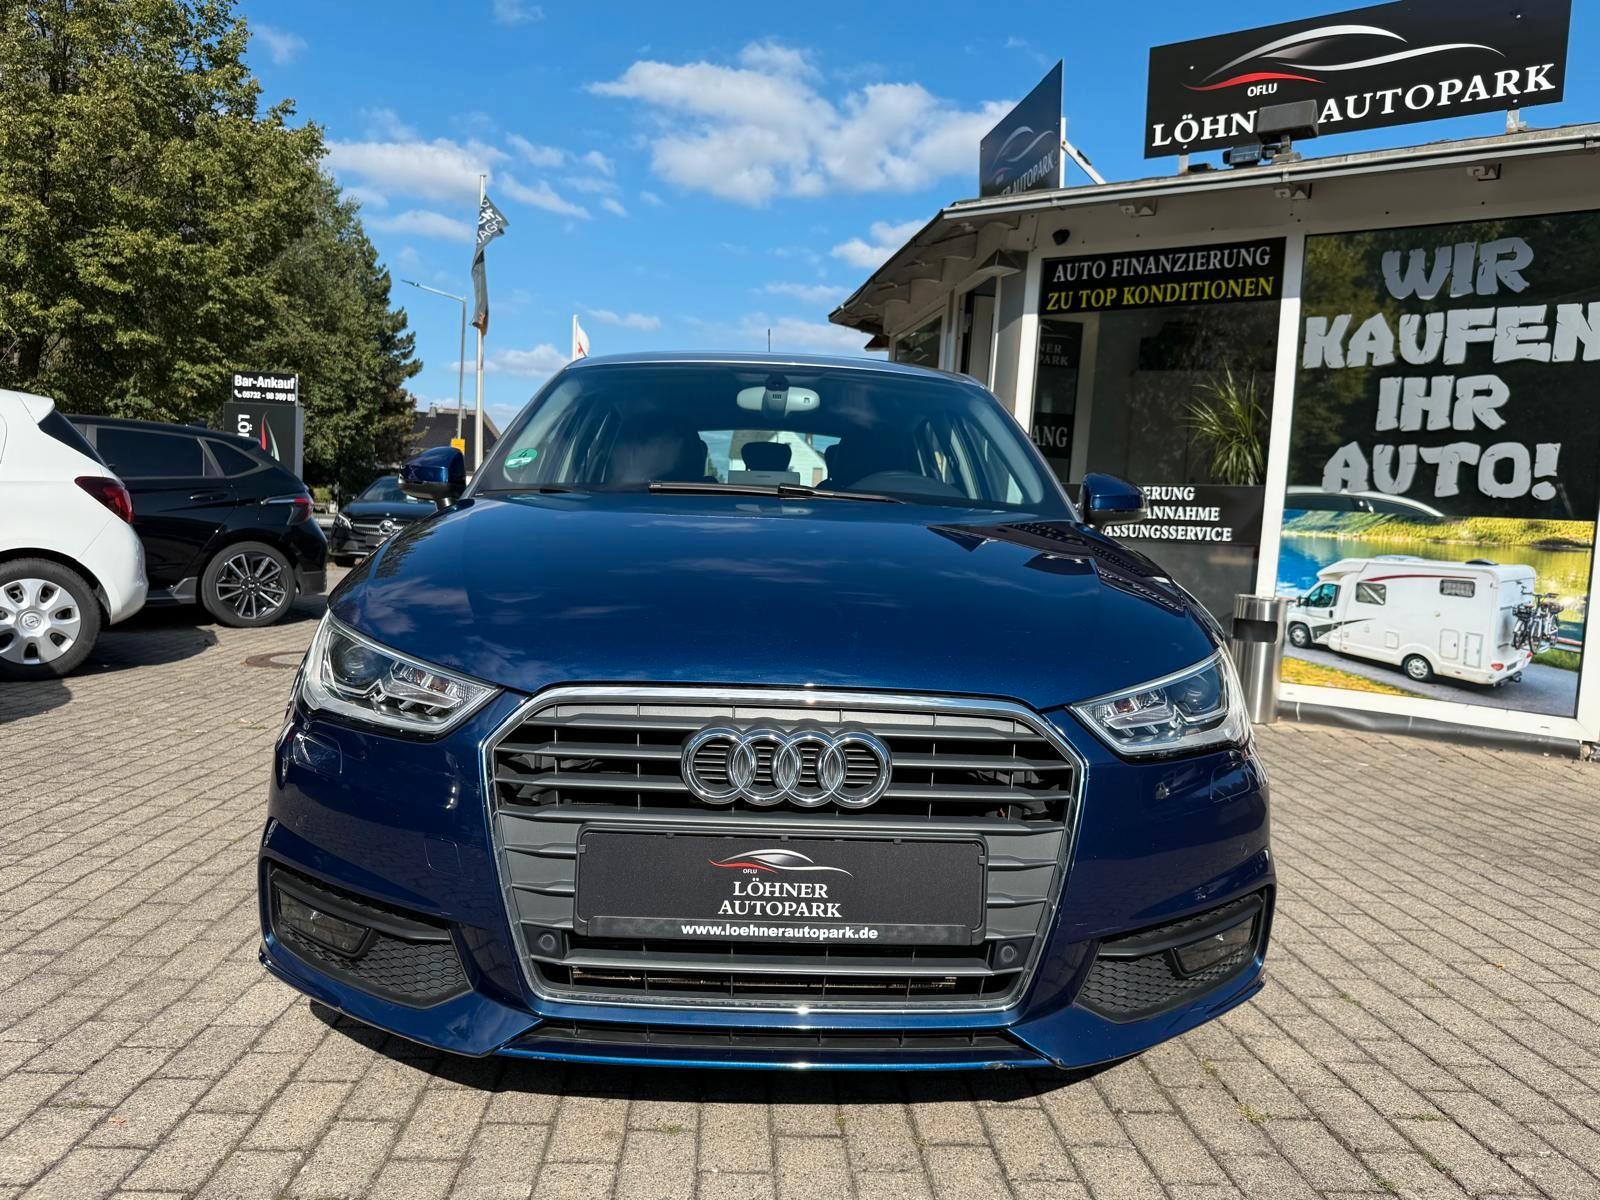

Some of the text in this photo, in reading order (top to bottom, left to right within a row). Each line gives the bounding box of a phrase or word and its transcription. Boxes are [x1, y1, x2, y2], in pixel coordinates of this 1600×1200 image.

[1152, 63, 1556, 147] LÖHN AUTOPARK
[1247, 83, 1278, 97] OFLU
[1053, 246, 1271, 282] AUTO FINANZIERUNG
[1381, 237, 1534, 300] WIR
[1046, 276, 1274, 310] ZU TOP KONDITIONEN
[1302, 301, 1600, 369] KAUFEN
[234, 375, 295, 389] Bar-Ankauf
[1375, 374, 1510, 431] IHR
[1321, 441, 1561, 500] AUTO!
[733, 877, 828, 898] LÖHNER
[718, 900, 842, 918] AUTOPARK
[681, 924, 879, 940] www.loehnerautopark.de
